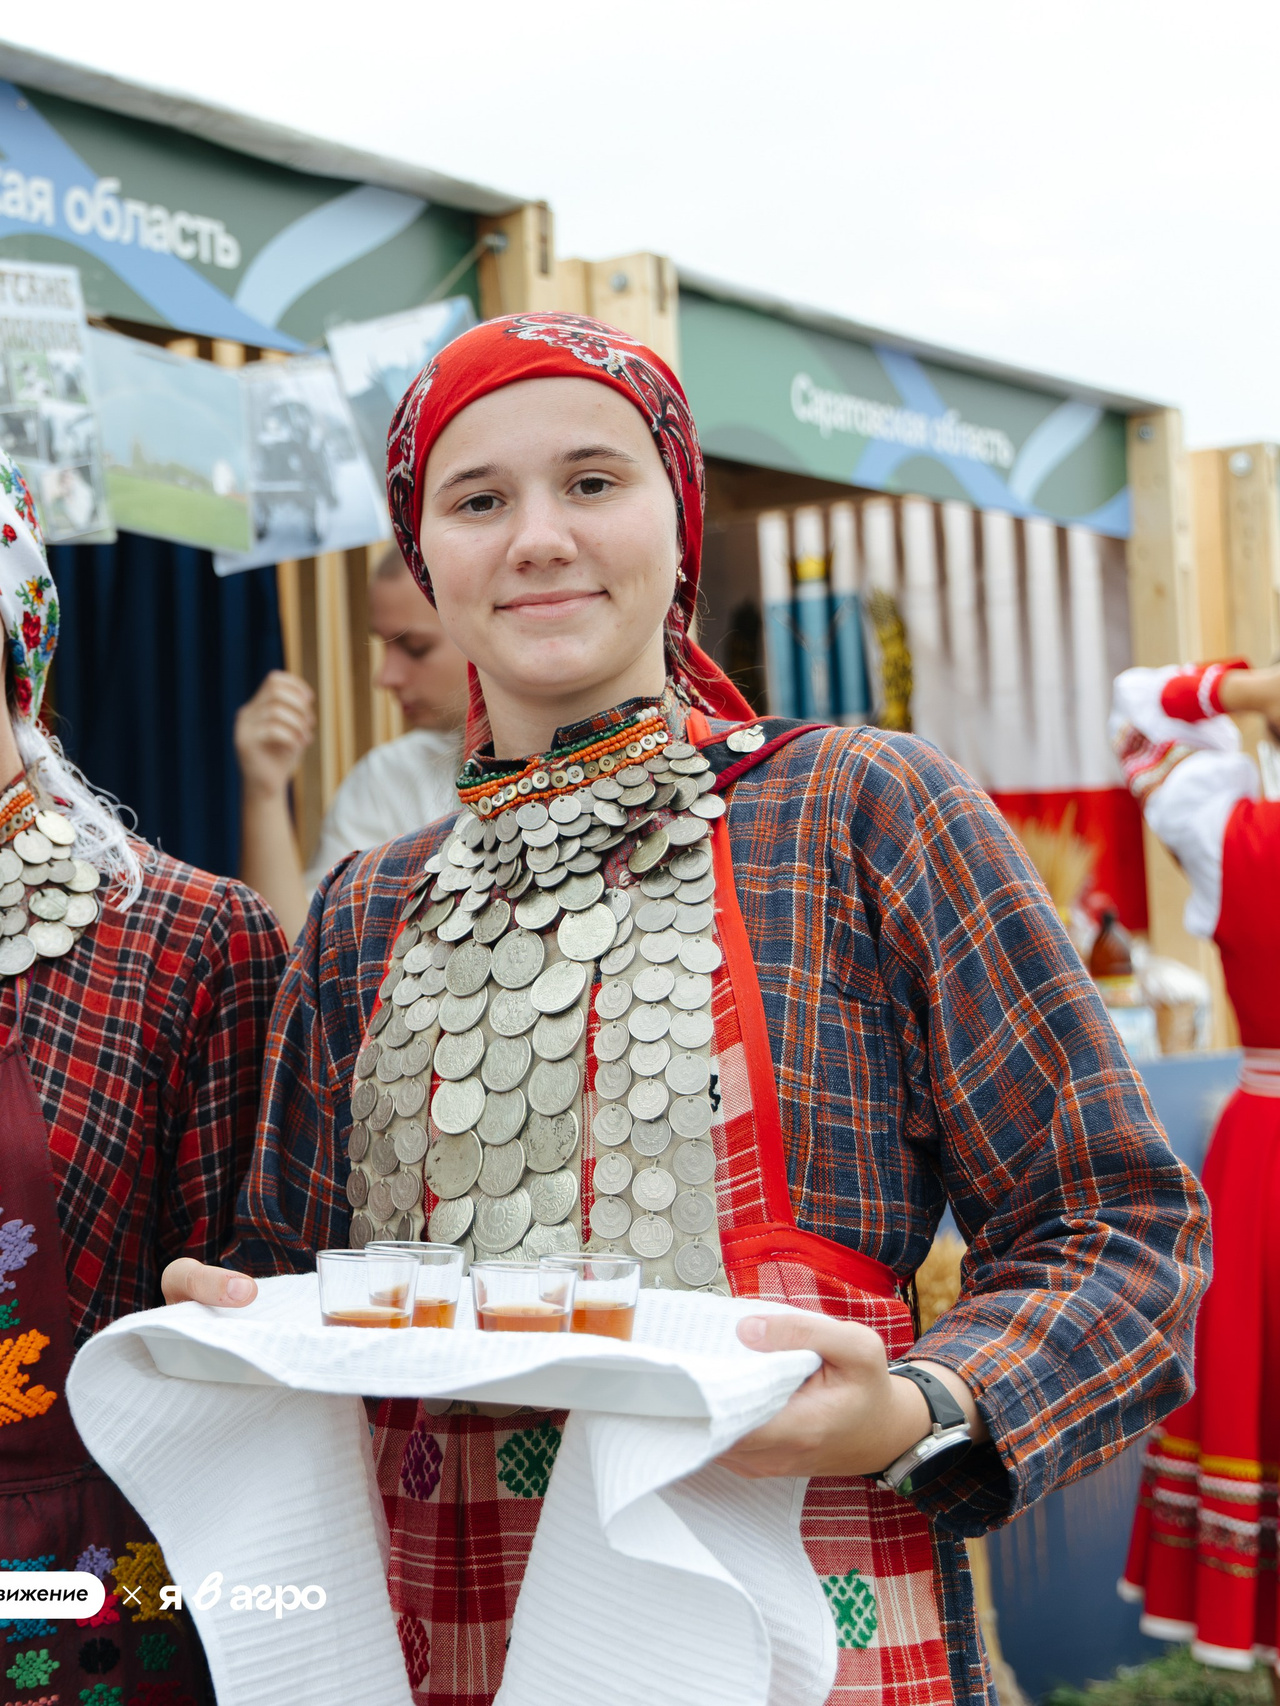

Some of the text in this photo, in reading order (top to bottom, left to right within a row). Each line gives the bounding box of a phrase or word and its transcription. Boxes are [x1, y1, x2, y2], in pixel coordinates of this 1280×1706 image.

[64, 177, 241, 270] область
[790, 371, 928, 448] Саратовская
[639, 1223, 662, 1242] 20
